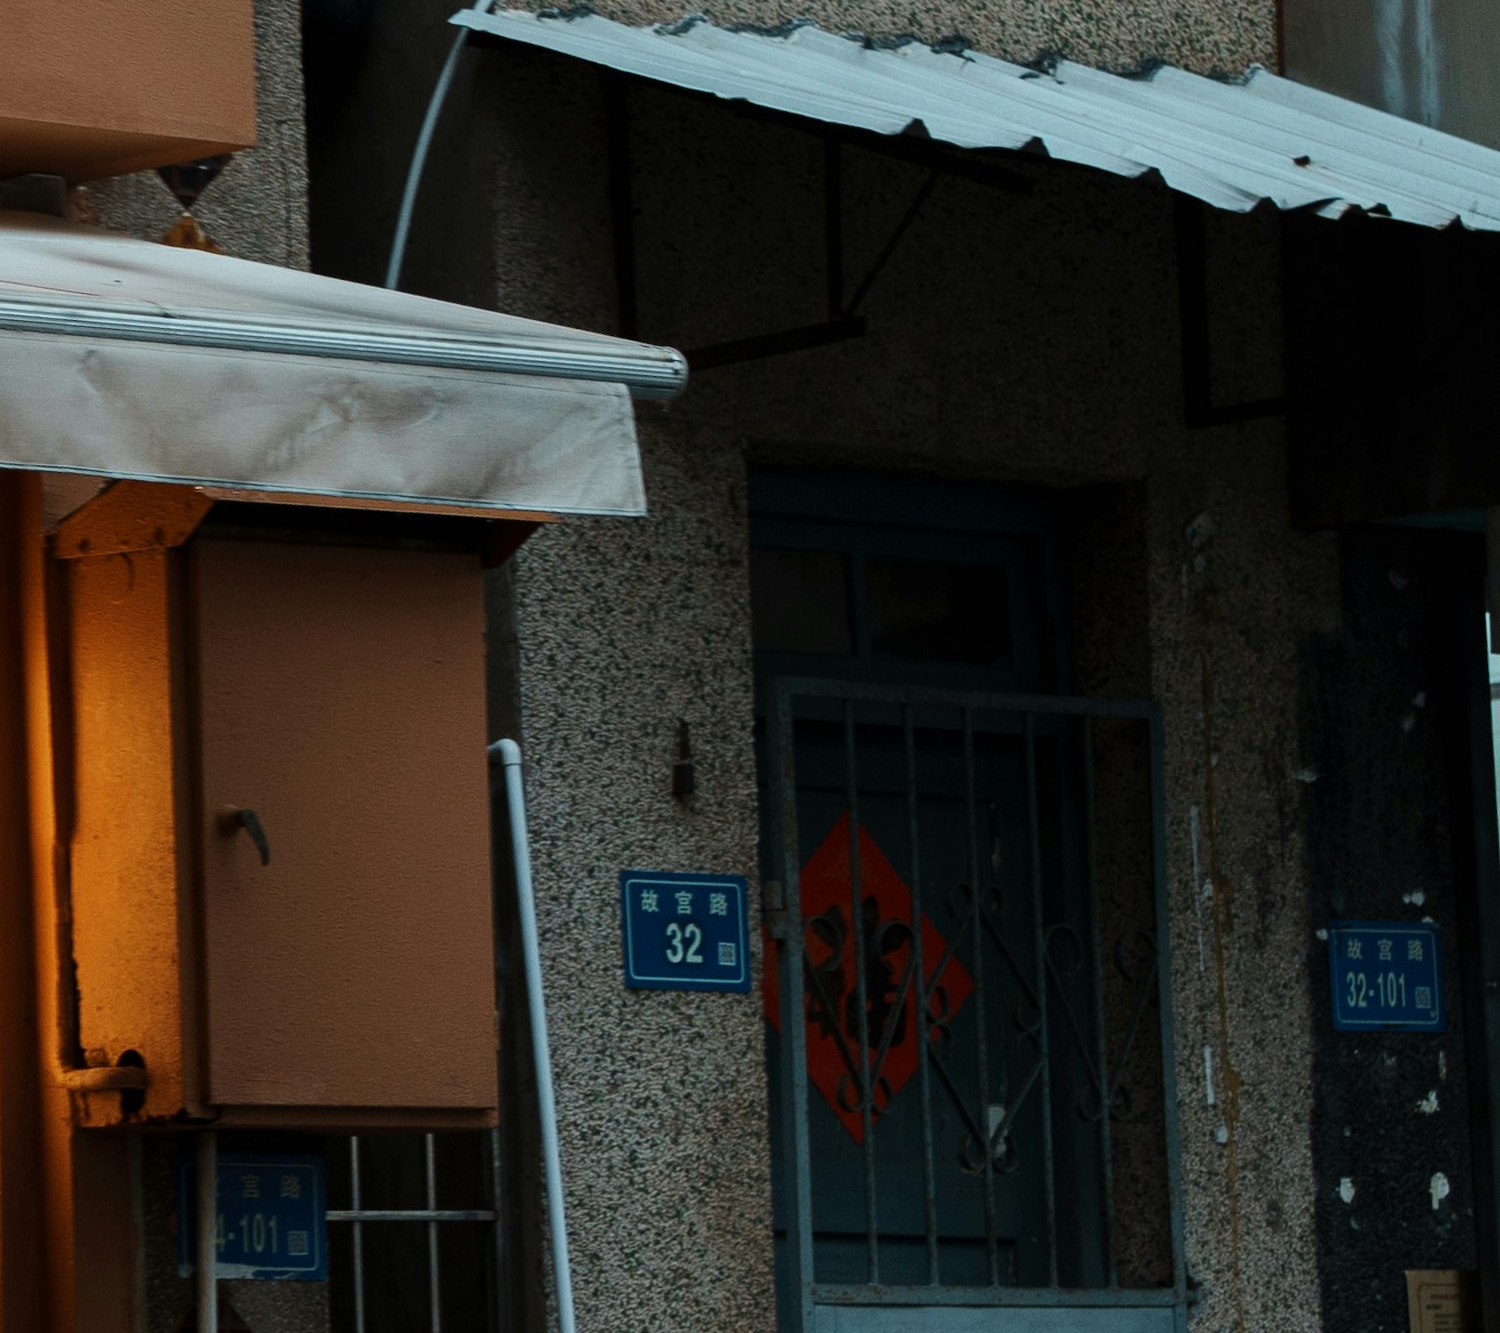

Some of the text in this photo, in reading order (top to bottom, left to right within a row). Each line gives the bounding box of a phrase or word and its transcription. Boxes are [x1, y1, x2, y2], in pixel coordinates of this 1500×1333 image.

[640, 889, 729, 916] 故宫路
[665, 922, 704, 964] 32
[1346, 938, 1424, 962] 故宫路
[1346, 971, 1407, 1008] 32-101
[217, 1172, 302, 1200] 宫路
[216, 1213, 279, 1254] 4-101
